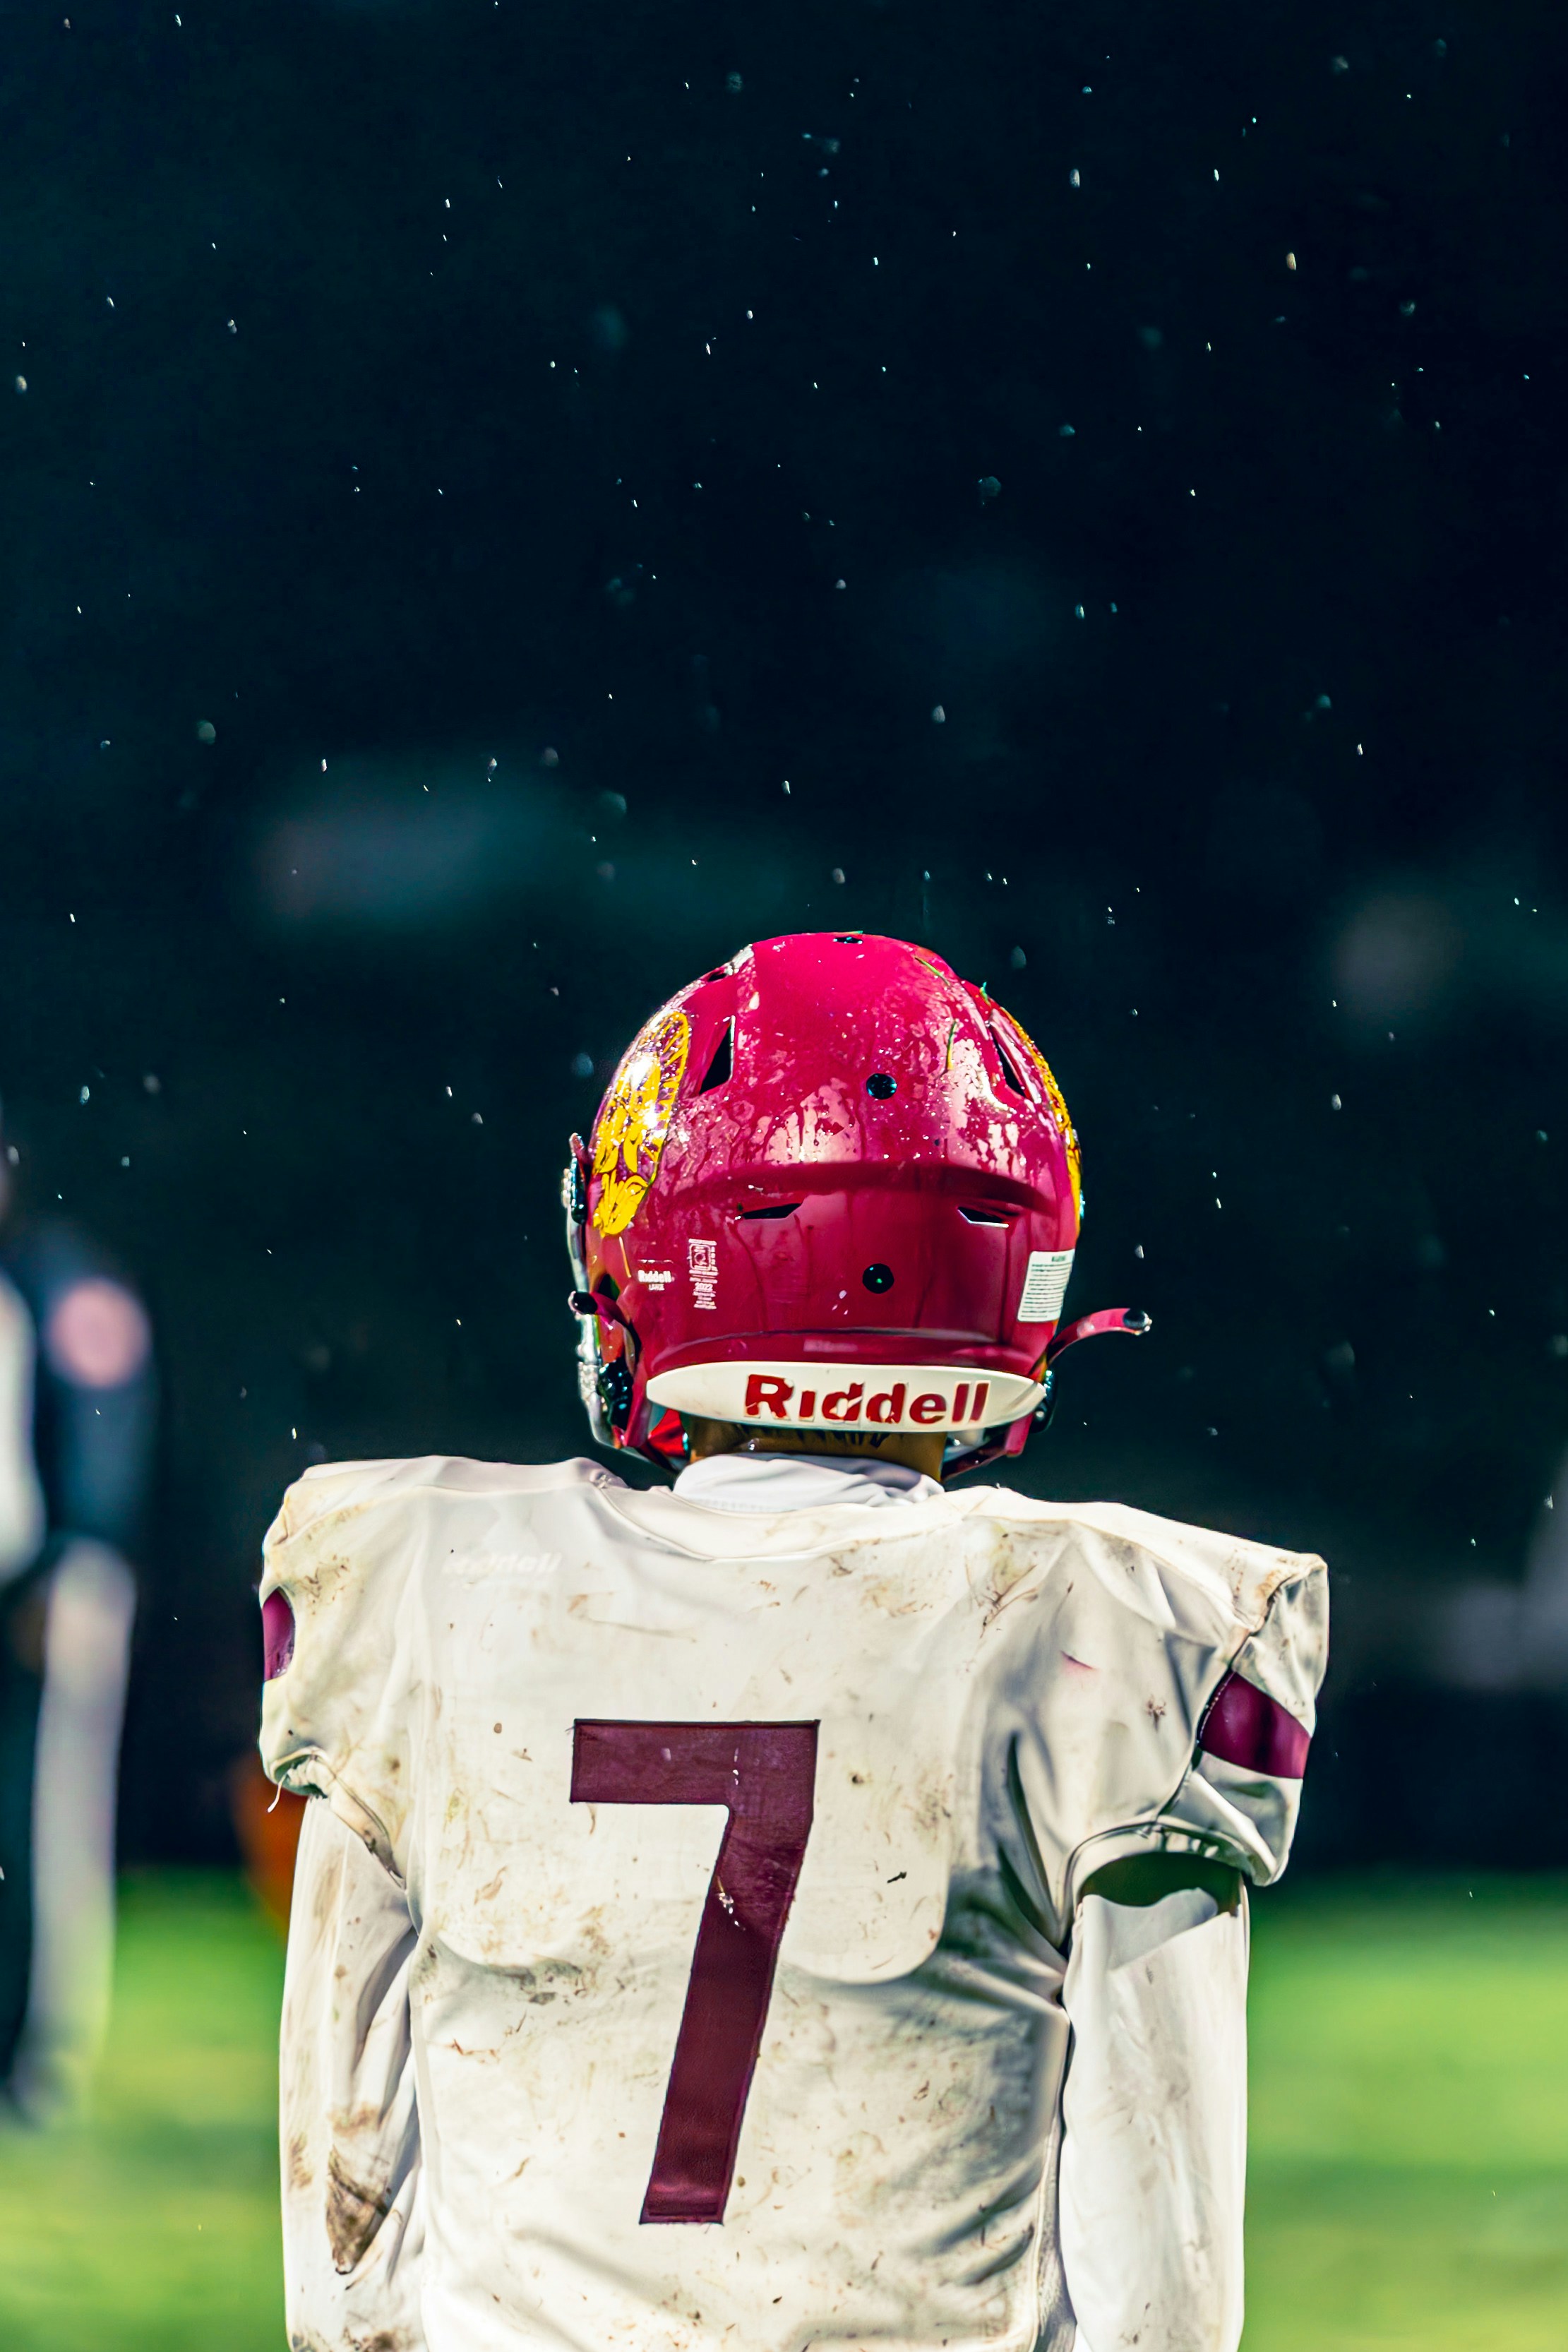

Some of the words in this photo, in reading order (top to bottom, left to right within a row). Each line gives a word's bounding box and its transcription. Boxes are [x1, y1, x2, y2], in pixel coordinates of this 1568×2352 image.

[638, 1270, 671, 1282] Riddell
[745, 1373, 991, 1425] Riddell
[570, 1719, 820, 2224] 7
